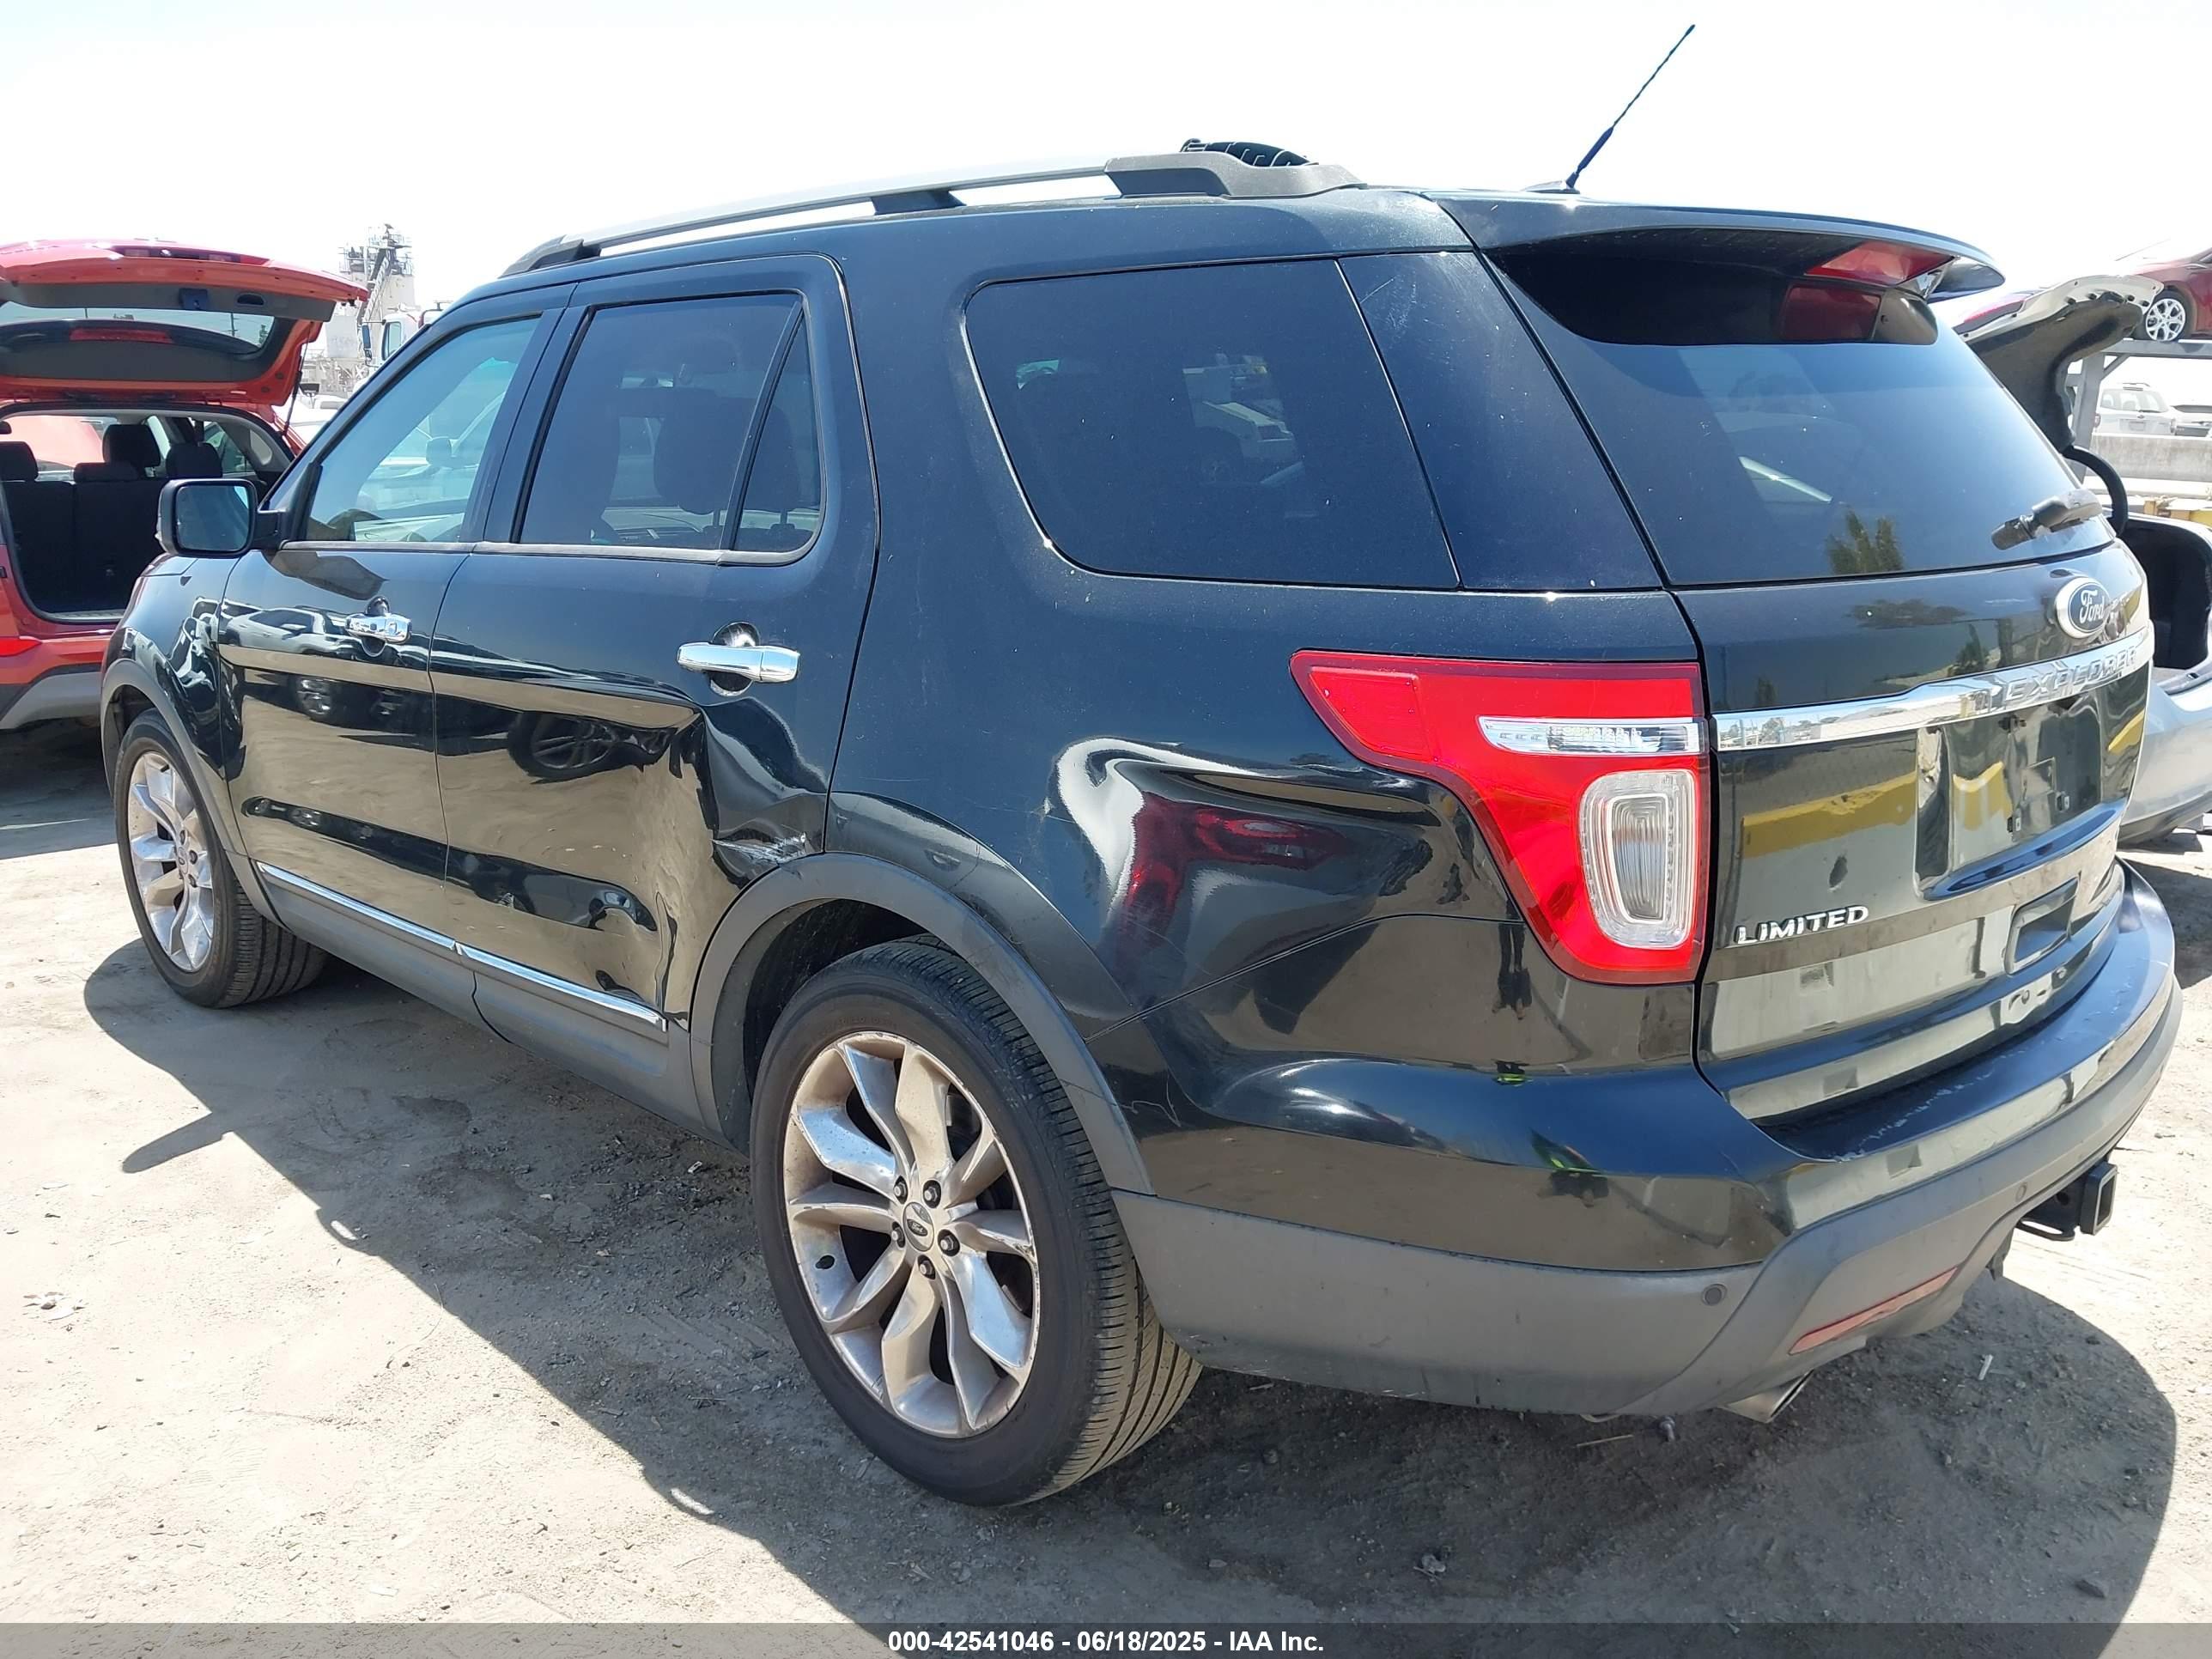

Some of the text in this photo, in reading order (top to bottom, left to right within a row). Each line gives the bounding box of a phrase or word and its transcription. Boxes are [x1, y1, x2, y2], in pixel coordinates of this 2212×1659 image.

[2080, 589, 2105, 623] Ford
[2005, 646, 2138, 701] EXPLORER
[1735, 905, 1869, 945] LIMITED
